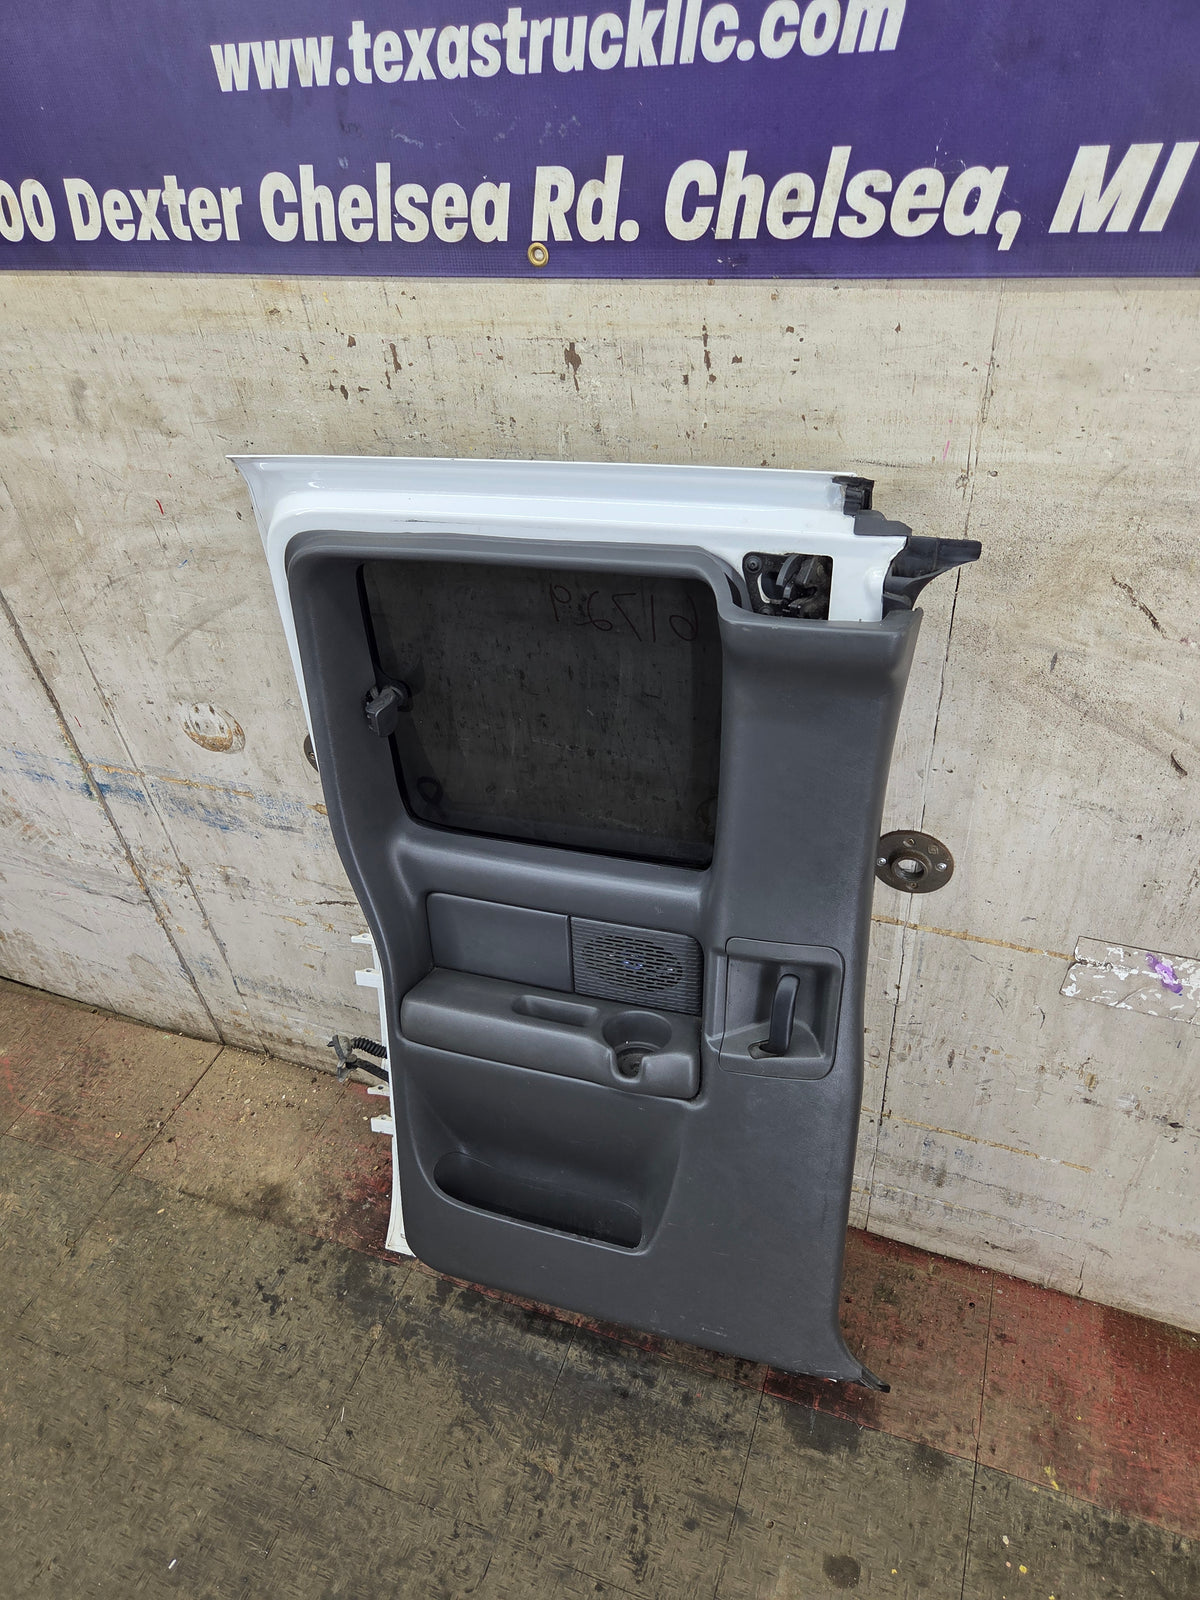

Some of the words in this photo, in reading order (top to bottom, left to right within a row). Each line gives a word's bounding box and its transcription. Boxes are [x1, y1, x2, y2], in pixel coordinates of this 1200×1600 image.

[210, 0, 906, 92] www.texastruckllc.com
[63, 176, 242, 242] Dexter
[260, 162, 510, 242] Chelsea
[532, 155, 639, 242] Rd.
[665, 146, 1021, 251] Chelsea,
[1048, 141, 1200, 233] MI
